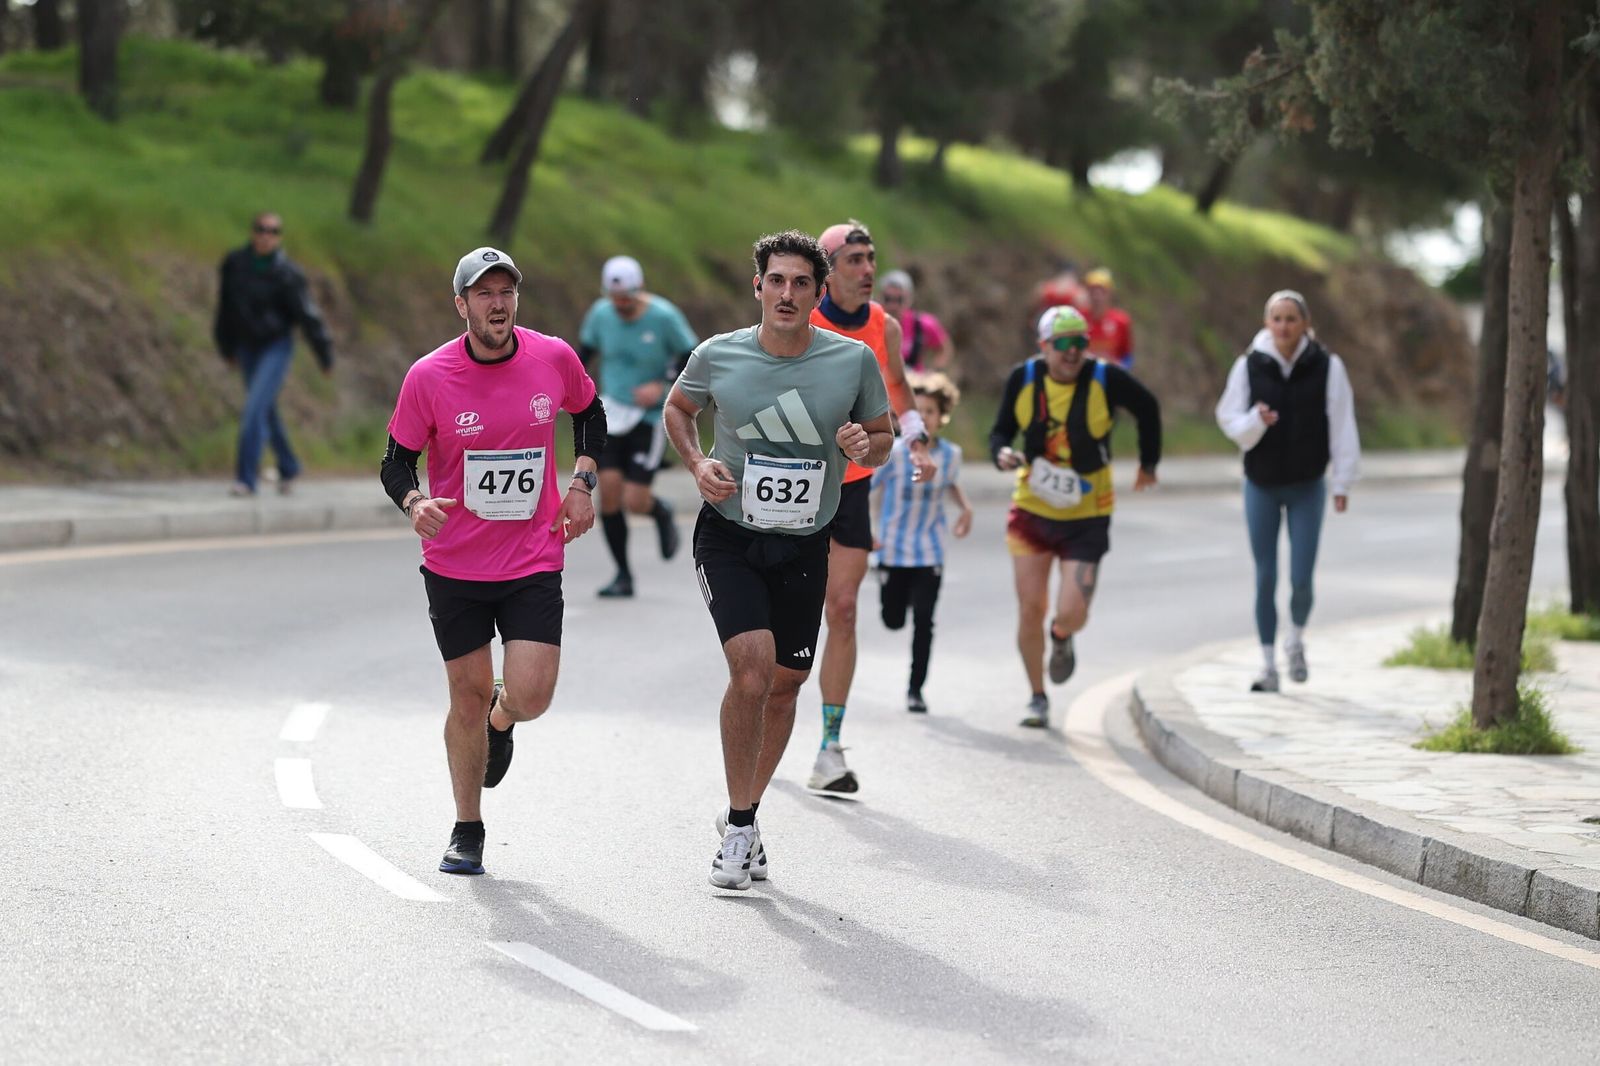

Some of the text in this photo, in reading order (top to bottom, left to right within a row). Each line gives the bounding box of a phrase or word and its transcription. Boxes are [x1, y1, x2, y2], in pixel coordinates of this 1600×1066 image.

[455, 424, 484, 434] HYUNDAI
[478, 468, 535, 495] 476
[756, 476, 810, 504] 632
[1040, 465, 1075, 495] 713
